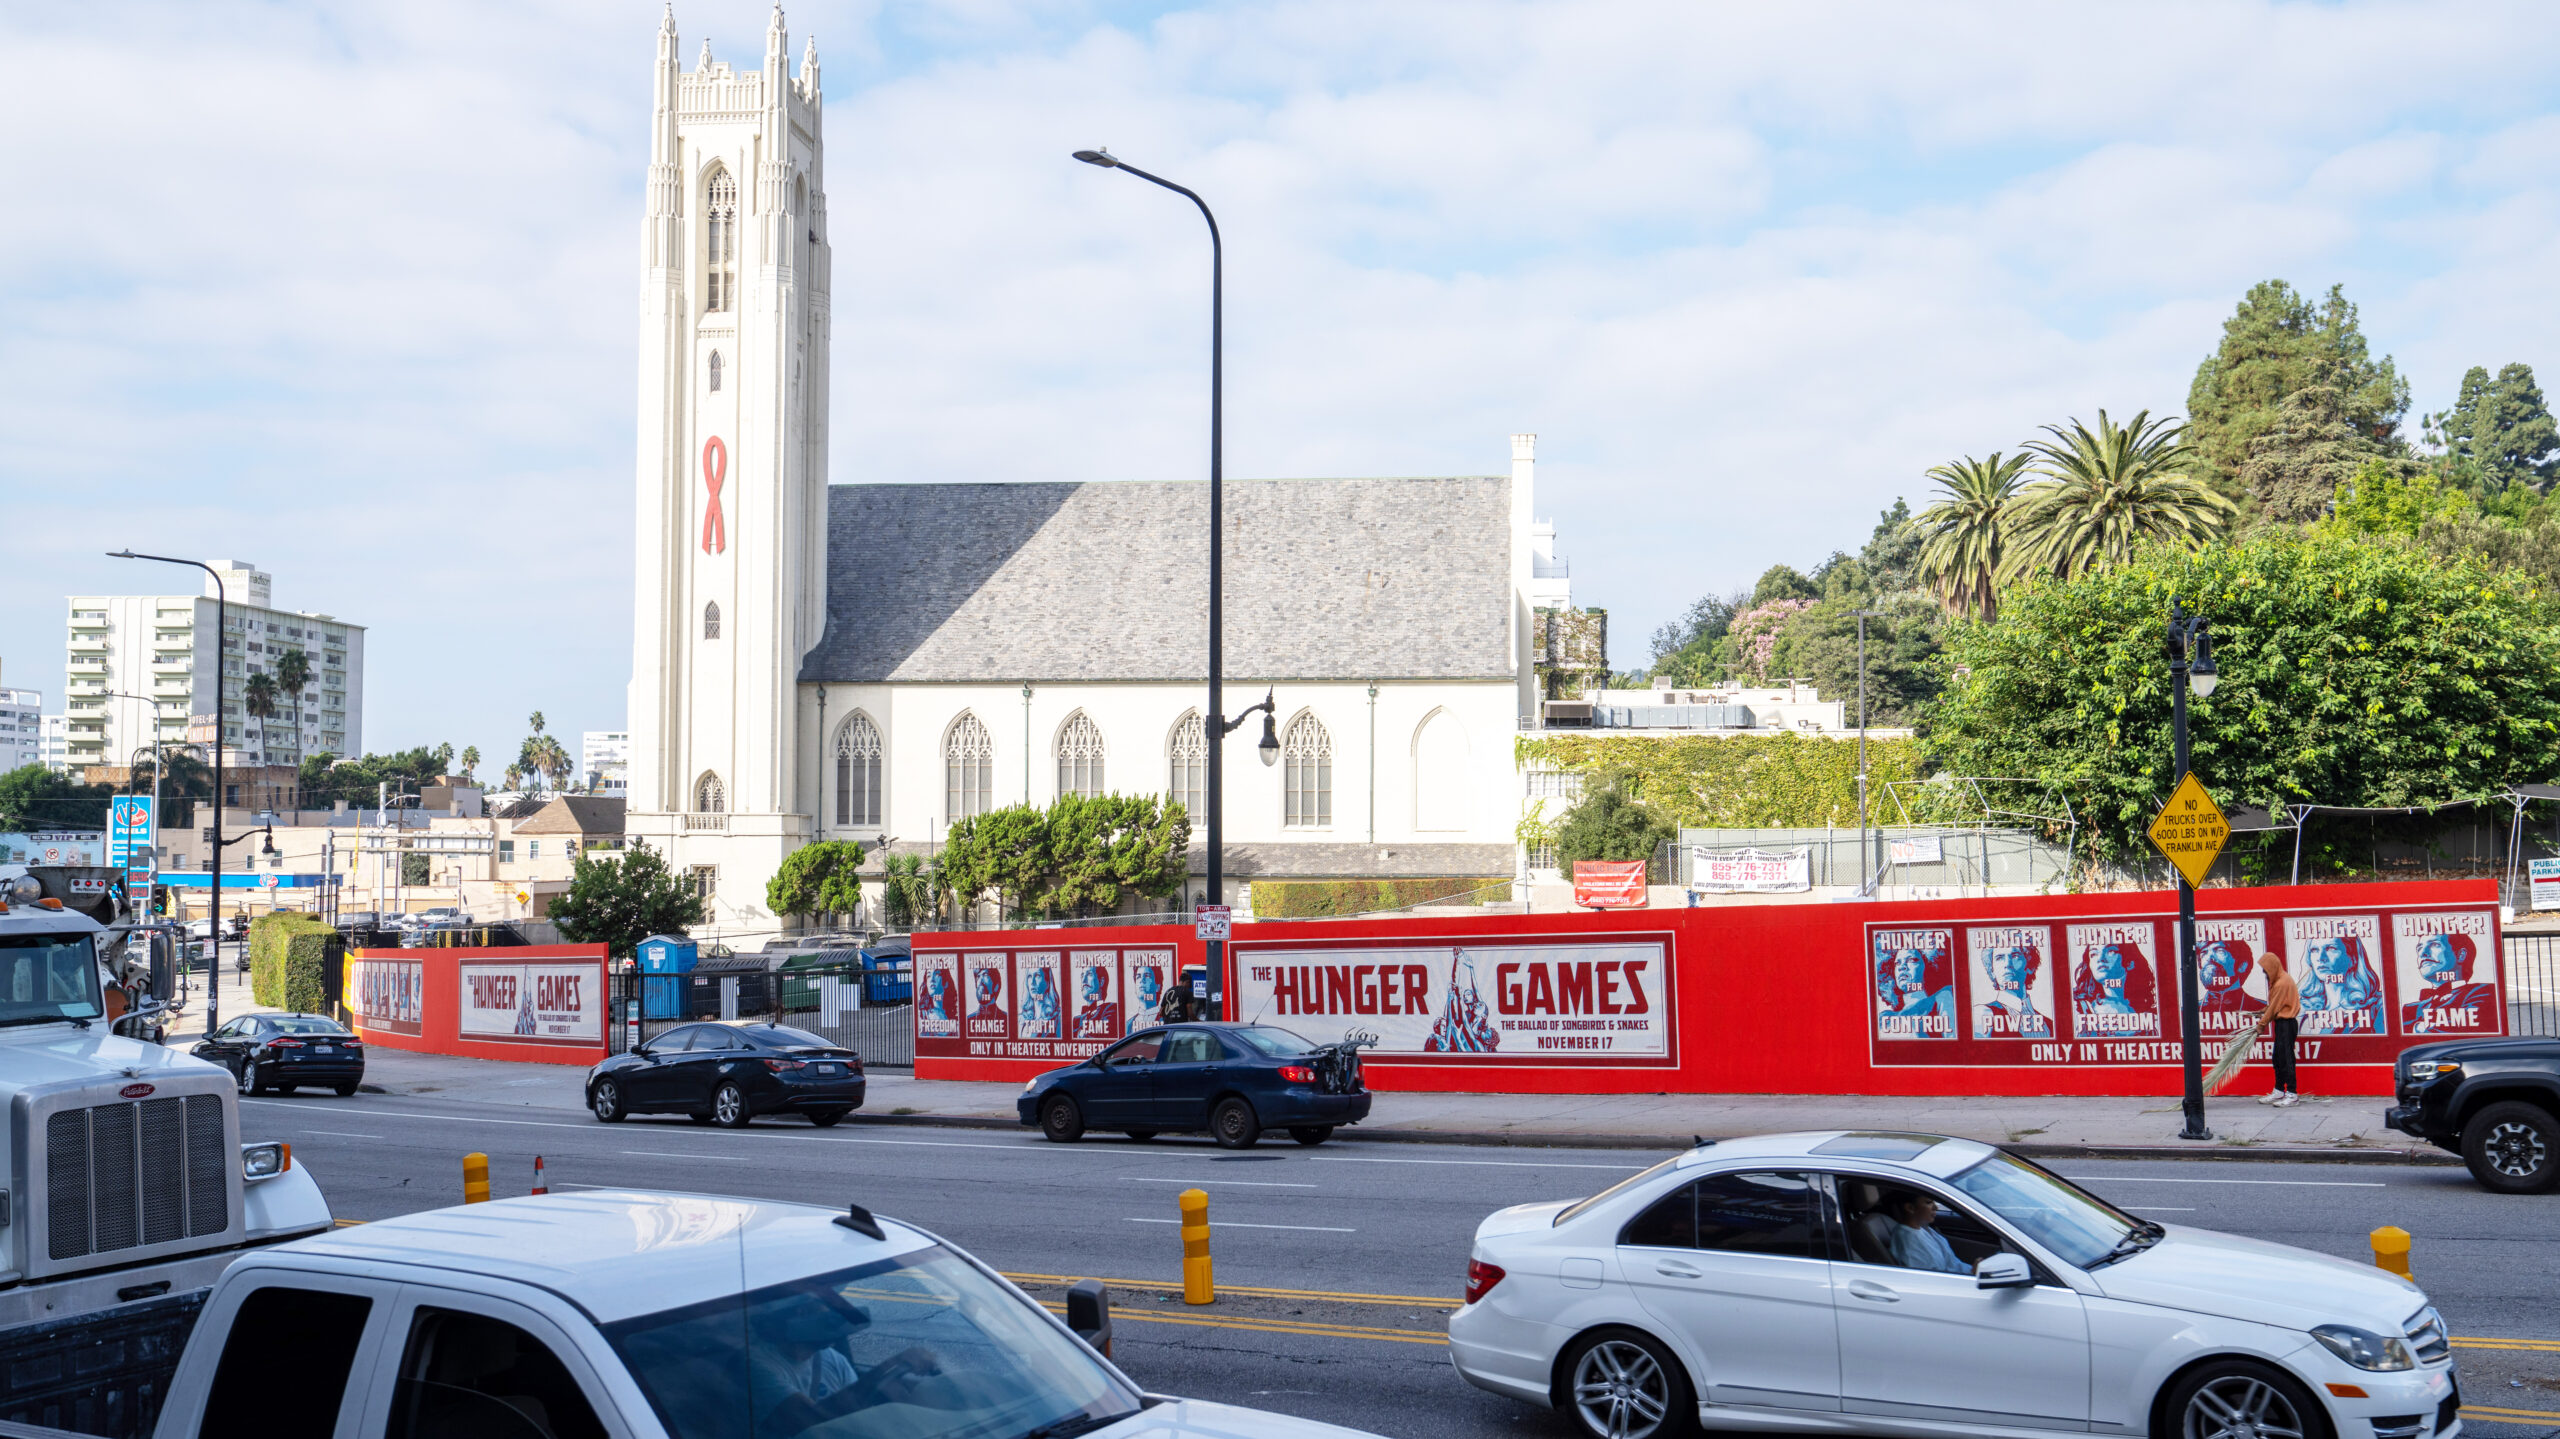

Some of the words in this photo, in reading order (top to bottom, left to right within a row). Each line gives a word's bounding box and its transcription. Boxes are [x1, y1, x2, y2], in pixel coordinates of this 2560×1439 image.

[2185, 799, 2197, 811] NO
[117, 802, 140, 826] VP
[2164, 814, 2195, 825] TRUCKS
[2199, 813, 2217, 823] OVER
[2157, 829, 2177, 840] 6000
[2181, 828, 2195, 838] LBS
[2198, 827, 2207, 837] ON
[2211, 826, 2224, 838] W/B
[1892, 843, 1915, 858] NO
[2166, 842, 2203, 853] FRANKLIN
[2205, 841, 2217, 850] AVE
[1575, 864, 1605, 873] PUBLIC
[1712, 862, 1787, 871] 855-776-7371
[1712, 871, 1788, 881] 855-776-7371
[2195, 922, 2257, 942] UNGER
[2293, 918, 2373, 939] HUNGER
[2402, 915, 2485, 936] HUNGER
[1880, 931, 1946, 950] HUNGER
[1974, 929, 2045, 949] HUNGER
[2074, 926, 2147, 946] HUNGER
[921, 956, 955, 970] HUNGER
[968, 956, 1004, 970] HUNGER
[1020, 955, 1058, 969] HUNGER
[1075, 953, 1114, 968] HUNGER
[1128, 952, 1169, 967] HUNGER
[2104, 978, 2122, 988] FOR
[2212, 976, 2230, 986] FOR
[2325, 974, 2344, 983] FOR
[2436, 971, 2456, 981] FOR
[1251, 966, 1272, 981] THE
[1273, 965, 1430, 1015] HUNGER
[1496, 961, 1649, 1018] GAMES
[1906, 982, 1922, 991] FOR
[2003, 981, 2019, 990] FOR
[473, 975, 516, 1010] HUNGER
[537, 975, 581, 1012] GAMES
[1881, 1015, 1953, 1033] CONTROL
[1982, 1014, 2045, 1034] POWER
[2076, 1012, 2153, 1032] FREEDOM
[2199, 1011, 2260, 1030] HANG
[2305, 1009, 2371, 1029] TRUTH
[2423, 1008, 2480, 1027] FAME
[920, 1019, 957, 1033] FREEDOM
[970, 1020, 1004, 1033] CHANGE
[1026, 1020, 1055, 1034] TRUTH
[1082, 1020, 1109, 1034] FAME
[1501, 1020, 1515, 1031] THE
[1518, 1020, 1548, 1031] BALLAD
[1551, 1020, 1559, 1031] OF
[1561, 1020, 1606, 1031] SONGBIRDS
[1608, 1020, 1614, 1030] &
[1617, 1020, 1649, 1031] SNAKES
[970, 1042, 991, 1055] ONLY
[995, 1042, 1003, 1055] IN
[1006, 1042, 1050, 1056] THEATERS
[1054, 1043, 1104, 1057] NOVEMBER
[1538, 1036, 1599, 1049] NOVEMBER
[1602, 1036, 1613, 1049] 17
[2032, 1043, 2072, 1062] ONLY
[2080, 1043, 2098, 1061] IN
[2104, 1043, 2183, 1061] THEATER
[2200, 1041, 2300, 1060] NOMBR
[2304, 1041, 2321, 1060] 17
